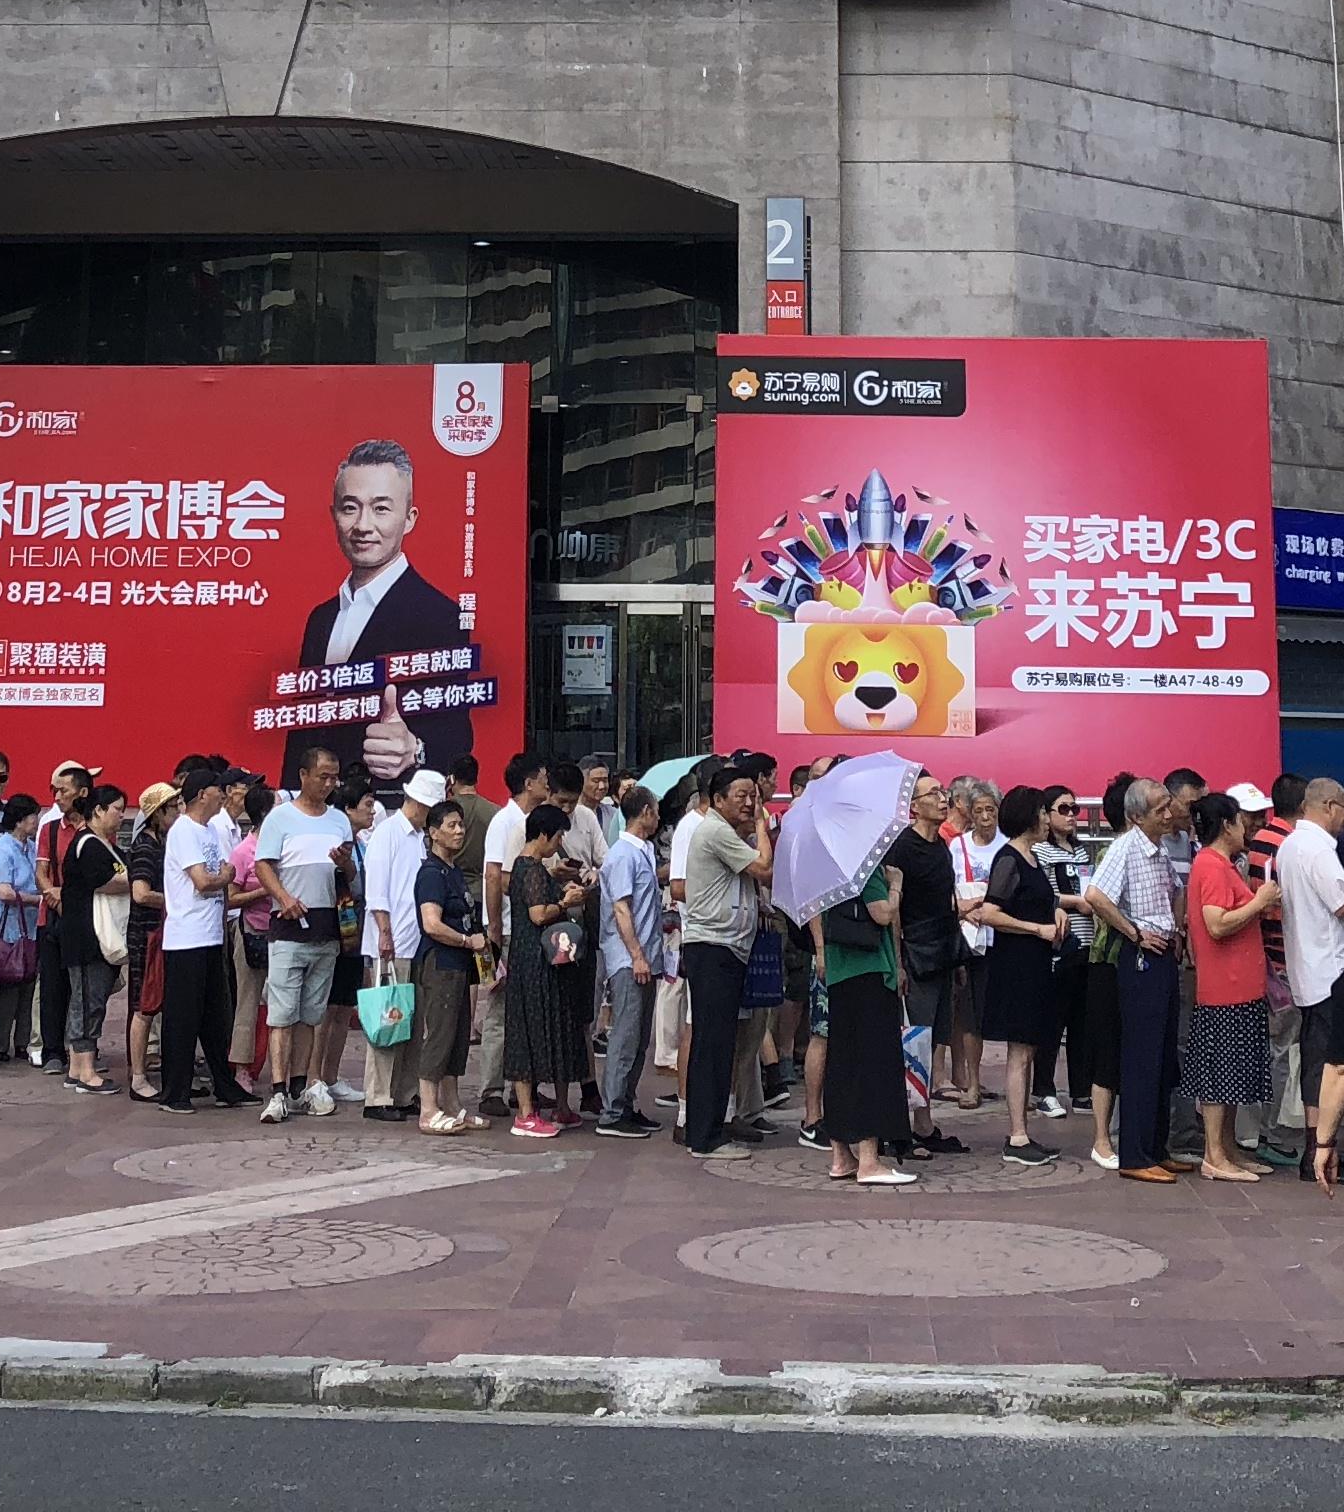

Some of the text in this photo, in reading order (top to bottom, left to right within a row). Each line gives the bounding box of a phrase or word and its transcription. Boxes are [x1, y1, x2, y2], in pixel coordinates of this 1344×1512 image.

[767, 219, 794, 264] 2
[769, 290, 796, 303] 入口
[768, 306, 802, 318] ENTRANCE
[764, 372, 840, 392] 苏宁易购
[891, 380, 941, 398] 和家
[764, 392, 840, 405] suning.com
[26, 411, 77, 429] 和家
[442, 415, 493, 428] 全民家装
[448, 429, 486, 442] 采购季
[1024, 514, 1256, 564] 买家电/3C
[9, 547, 251, 568] HEJIA HOME EXPO
[1286, 564, 1331, 584] charging
[7, 581, 268, 605] 8月2-4日 光大会展中心
[459, 593, 477, 630] 程雷
[1025, 571, 1255, 649] 来苏宁
[9, 642, 106, 667] 聚通装潢
[276, 647, 472, 695] 差价3倍返 买贵就赔
[254, 695, 380, 730] 我在和家家博
